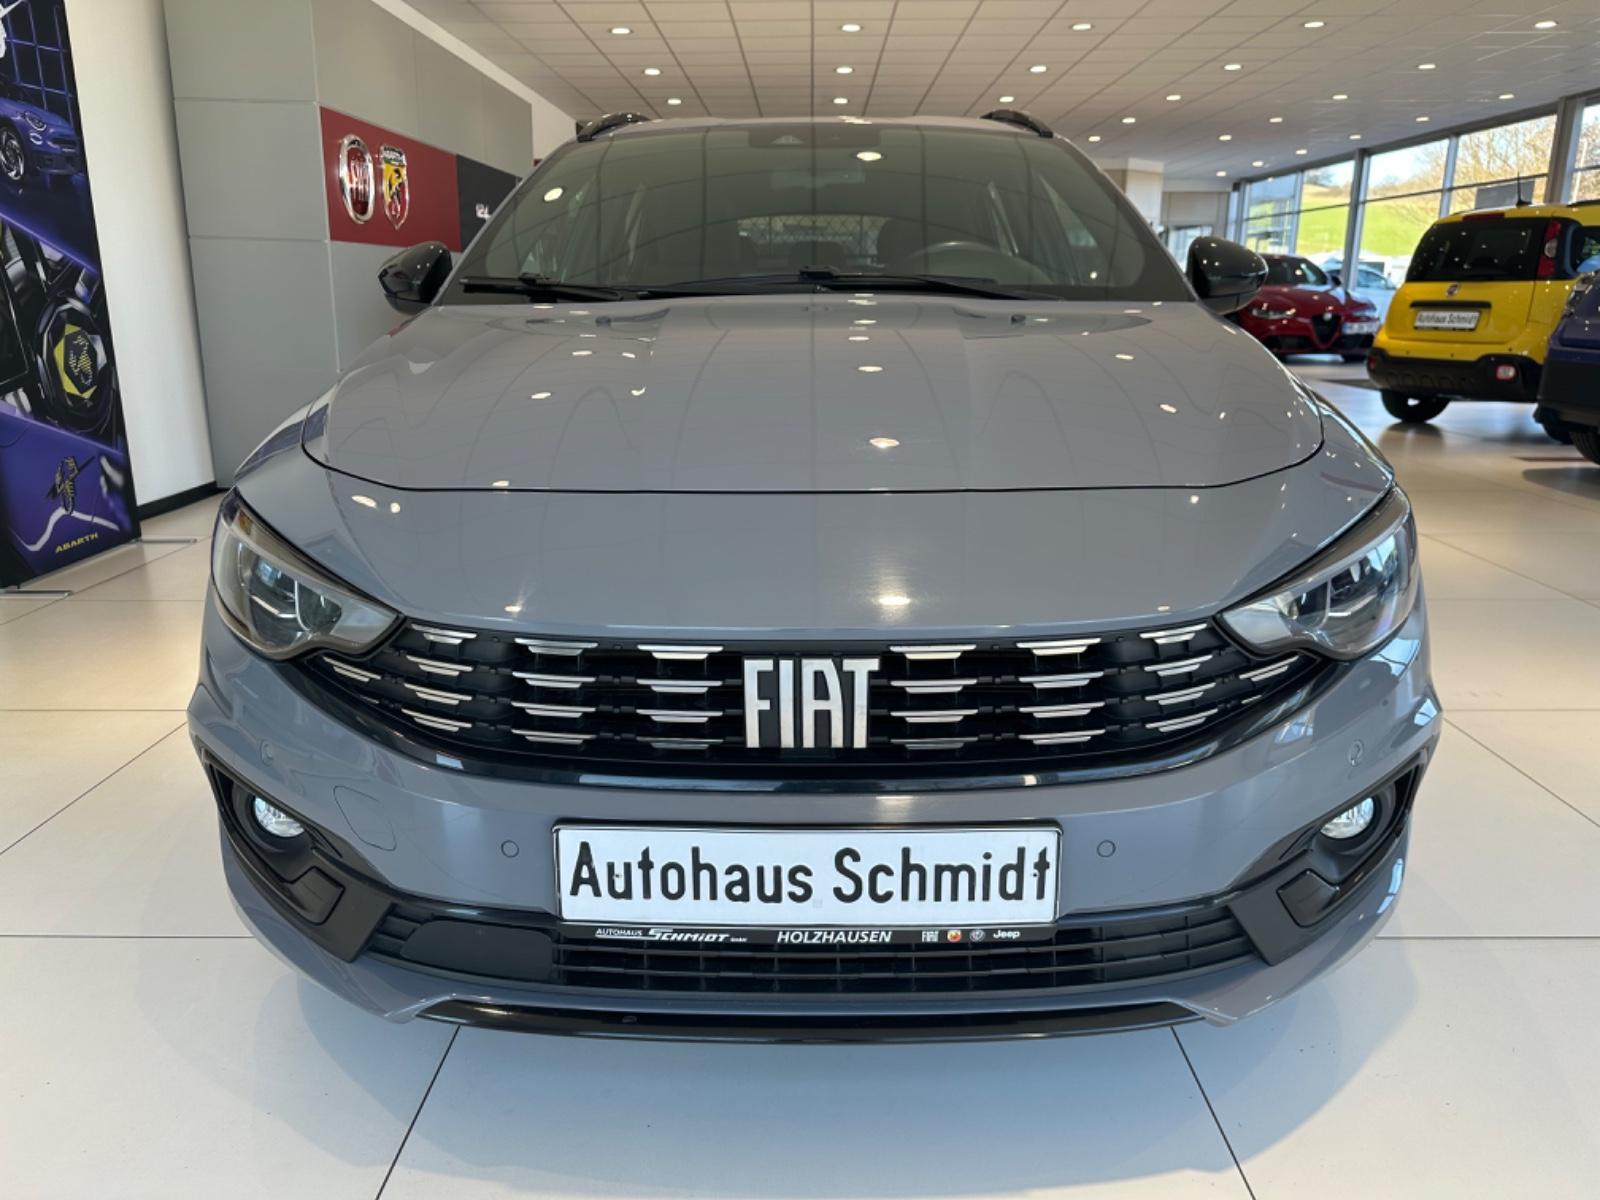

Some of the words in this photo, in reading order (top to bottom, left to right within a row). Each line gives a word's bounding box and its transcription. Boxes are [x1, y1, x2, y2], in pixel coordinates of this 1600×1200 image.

[55, 532, 98, 553] ABARTH
[743, 658, 880, 749] FIAT
[569, 840, 814, 903] Autohaus
[832, 846, 1050, 903] Schmidt
[596, 928, 643, 937] AUTOHAUS
[777, 930, 892, 944] HOLZHAUSEN
[993, 929, 1021, 940] Jeep
